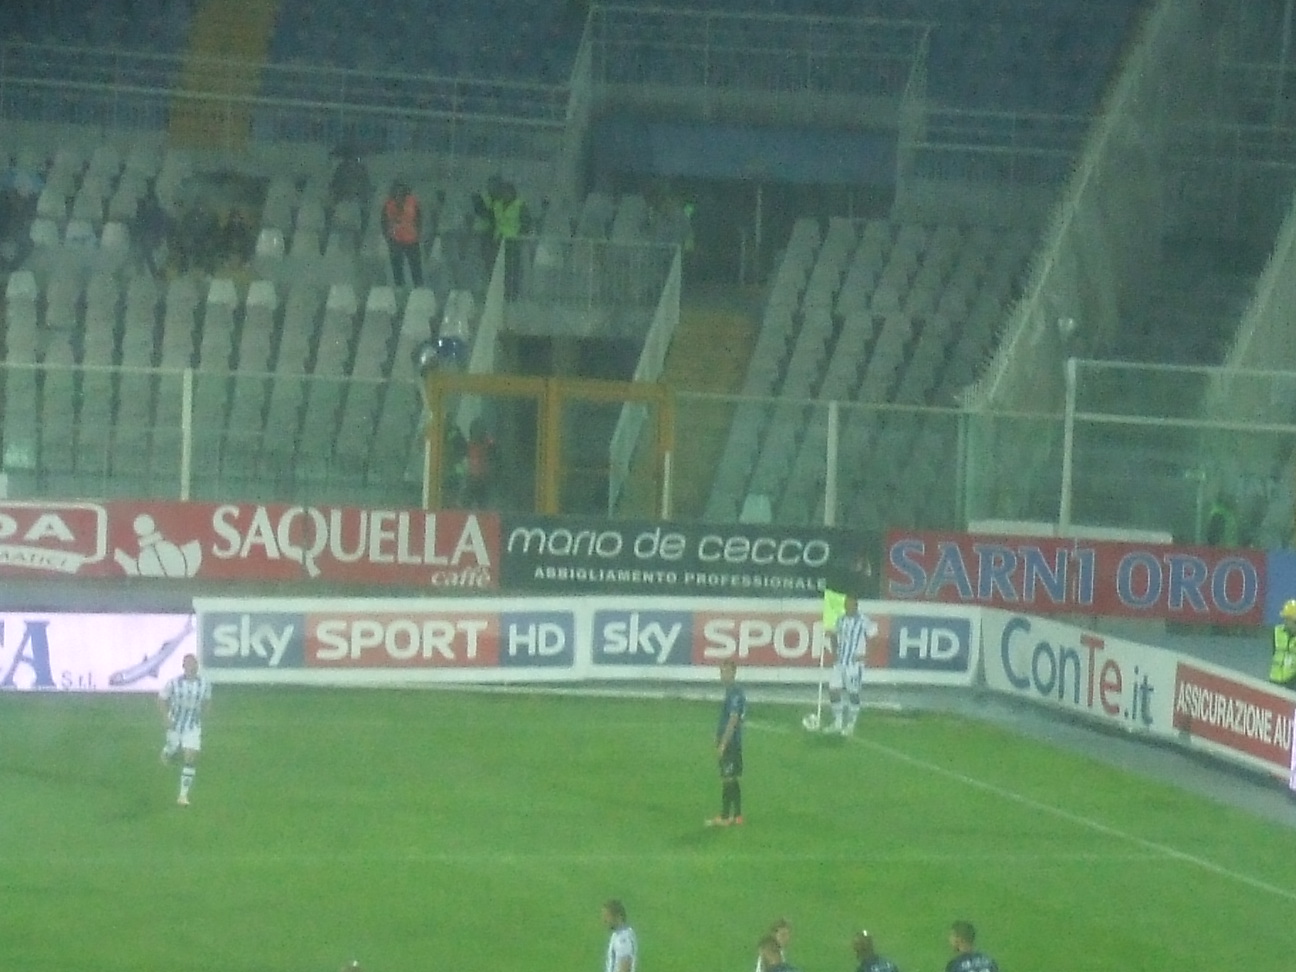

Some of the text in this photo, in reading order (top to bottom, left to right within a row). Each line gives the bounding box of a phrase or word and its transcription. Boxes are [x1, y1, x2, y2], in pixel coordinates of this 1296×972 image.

[212, 504, 491, 577] SAQUELLA
[507, 526, 831, 567] mario de cecco
[534, 566, 828, 591] ABBIGLIAMENTO PROFESSIONALE
[888, 538, 1259, 616] SARNI ORO
[212, 614, 566, 667] sky SPORT HD
[602, 612, 682, 664] sky
[898, 627, 961, 660] HD
[1000, 616, 1155, 725] ConTe.it
[1176, 681, 1273, 744] ASSICURAZIONE
